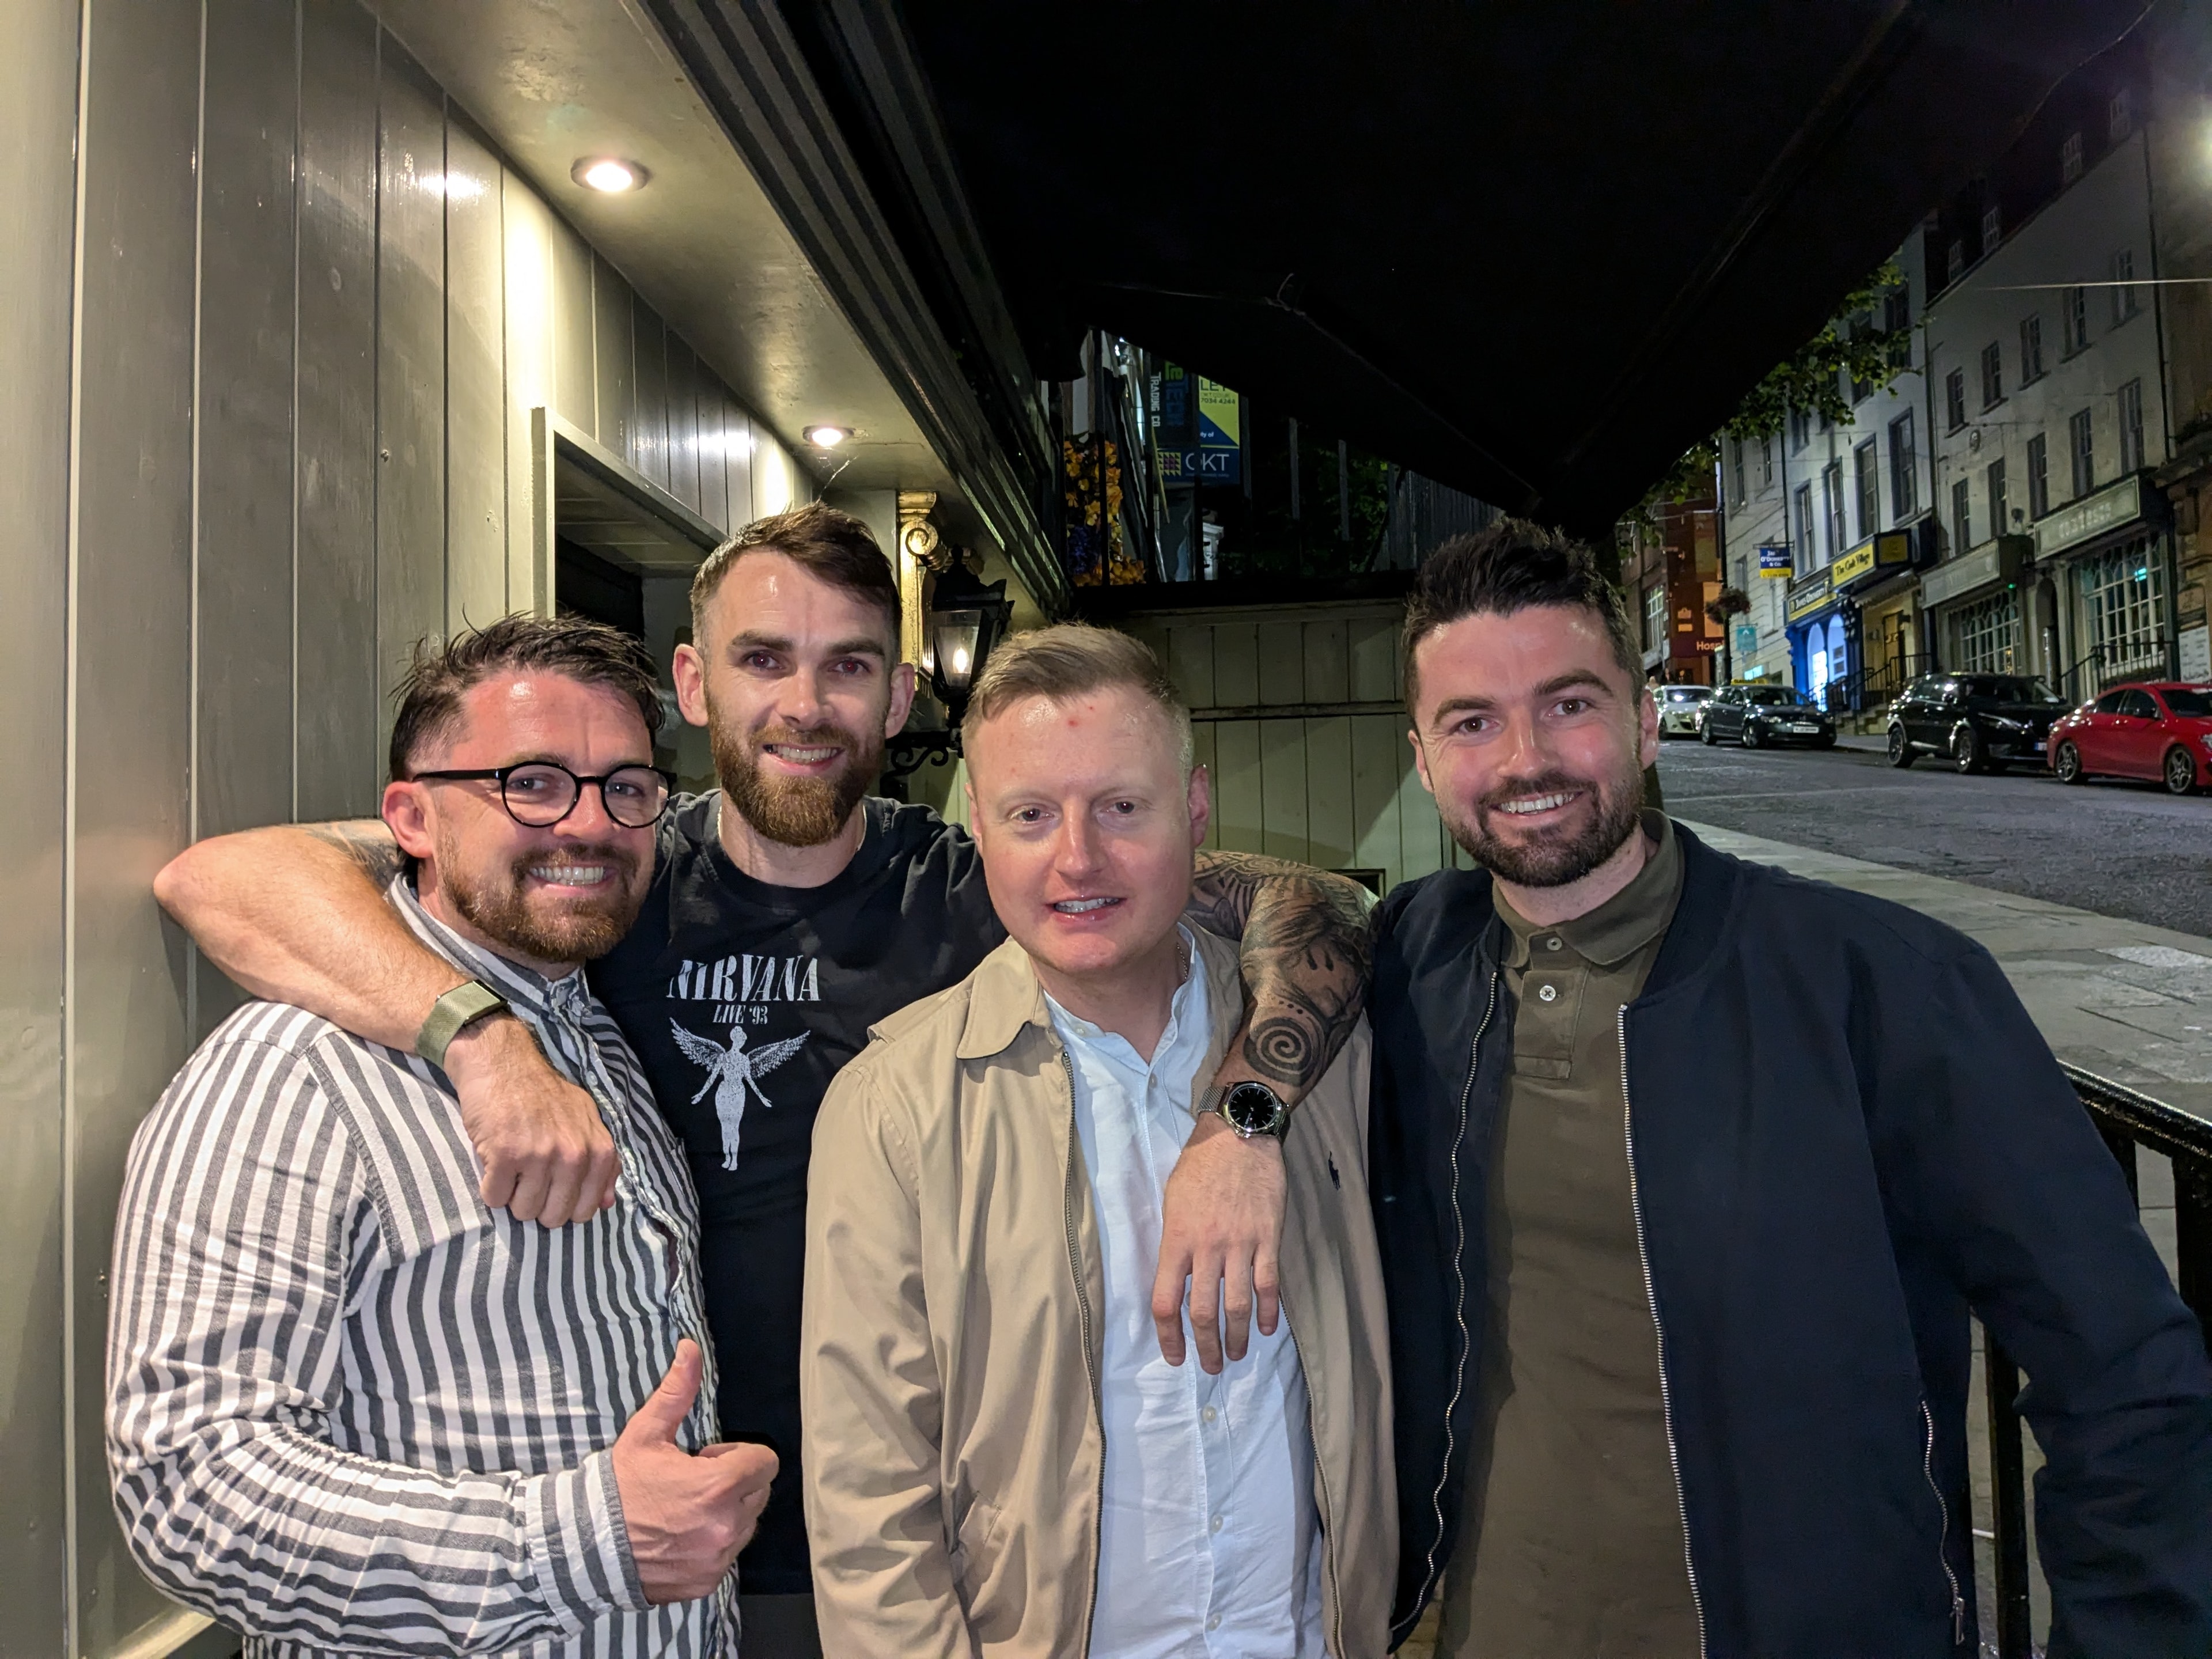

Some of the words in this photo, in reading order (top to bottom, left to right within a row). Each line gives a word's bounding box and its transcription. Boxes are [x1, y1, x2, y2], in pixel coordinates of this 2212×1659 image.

[1150, 372, 1161, 411] TRADING
[1200, 379, 1225, 391] LE
[1151, 415, 1161, 427] CO
[666, 954, 821, 1002] NIRVANA
[713, 1004, 745, 1024] LIVE
[749, 1005, 768, 1025] '93
